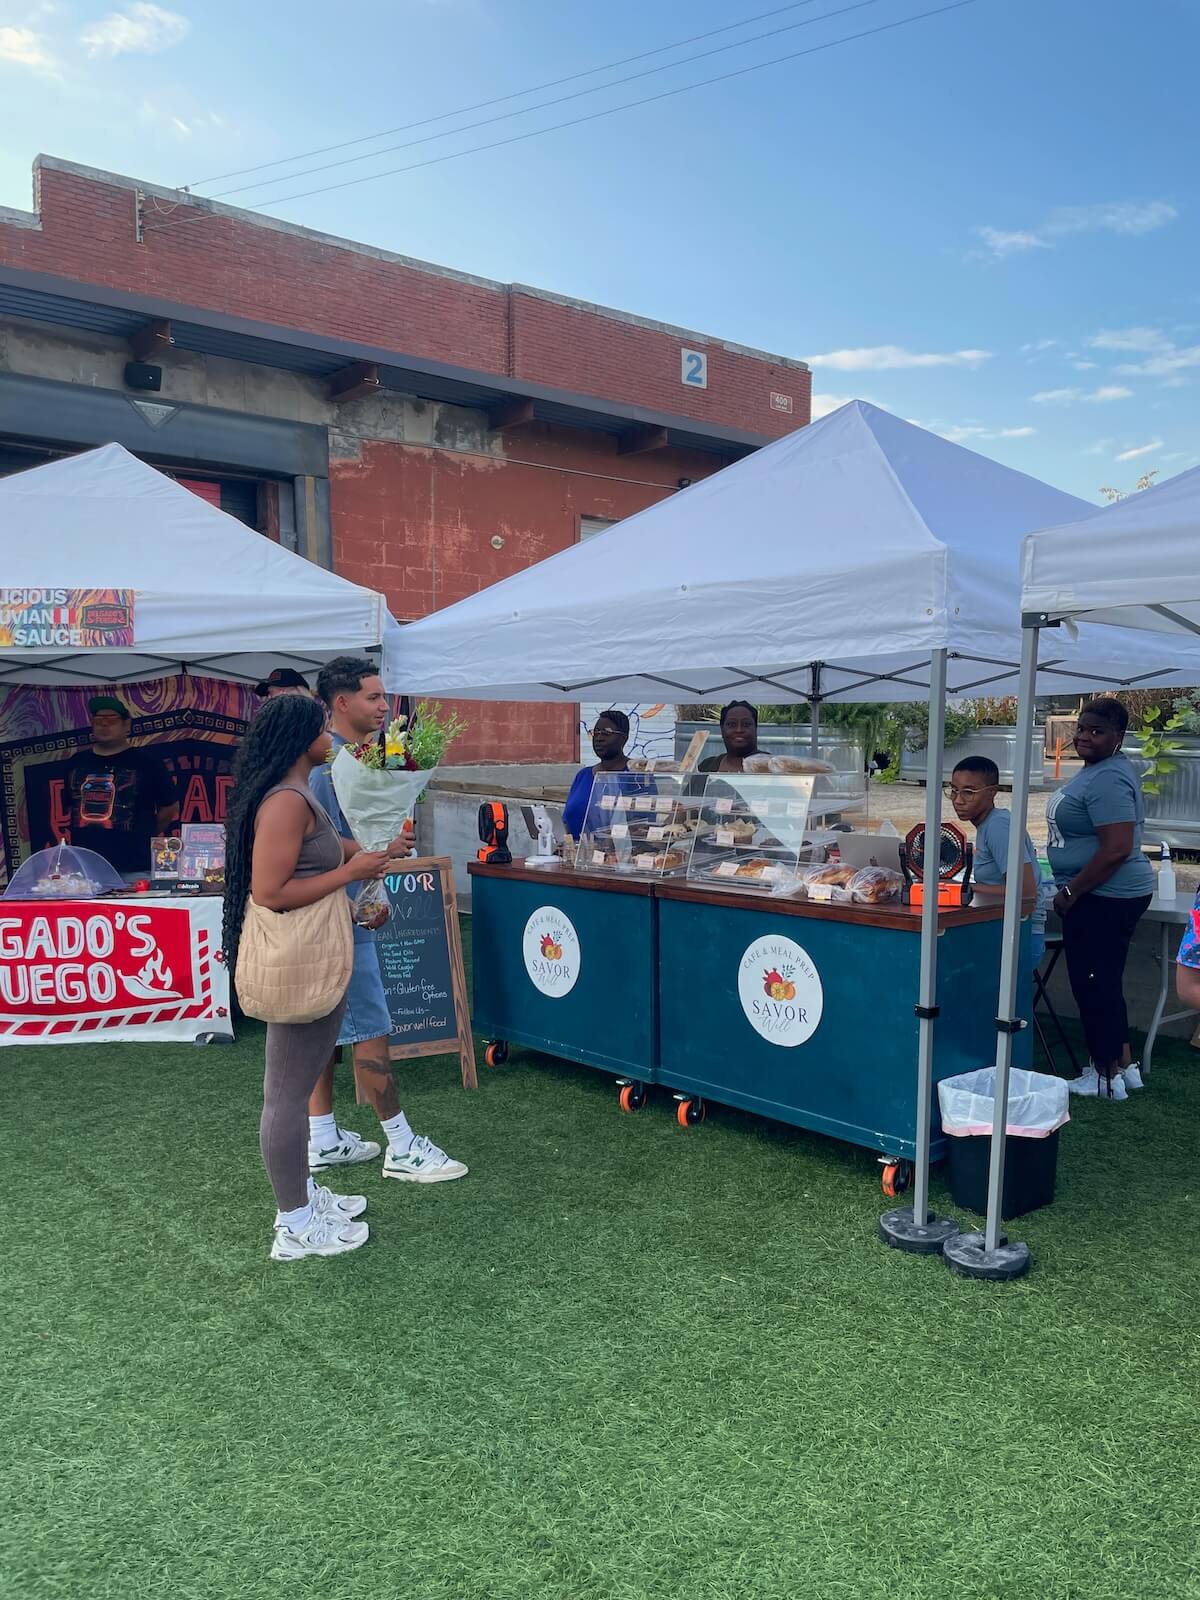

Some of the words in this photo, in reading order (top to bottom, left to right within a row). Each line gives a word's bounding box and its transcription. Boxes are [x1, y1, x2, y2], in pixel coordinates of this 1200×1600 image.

[686, 354, 703, 384] 2
[0, 589, 67, 604] ICIOUS
[15, 629, 81, 645] SAUCE
[0, 912, 156, 959] GADO'S
[532, 960, 570, 978] SAVOR
[743, 949, 761, 969] CAFE
[763, 947, 769, 955] &
[771, 945, 793, 960] MEAL
[795, 956, 815, 980] PREP
[0, 962, 117, 1004] UEGO
[752, 1000, 809, 1024] SAVOR
[411, 1156, 424, 1167] N
